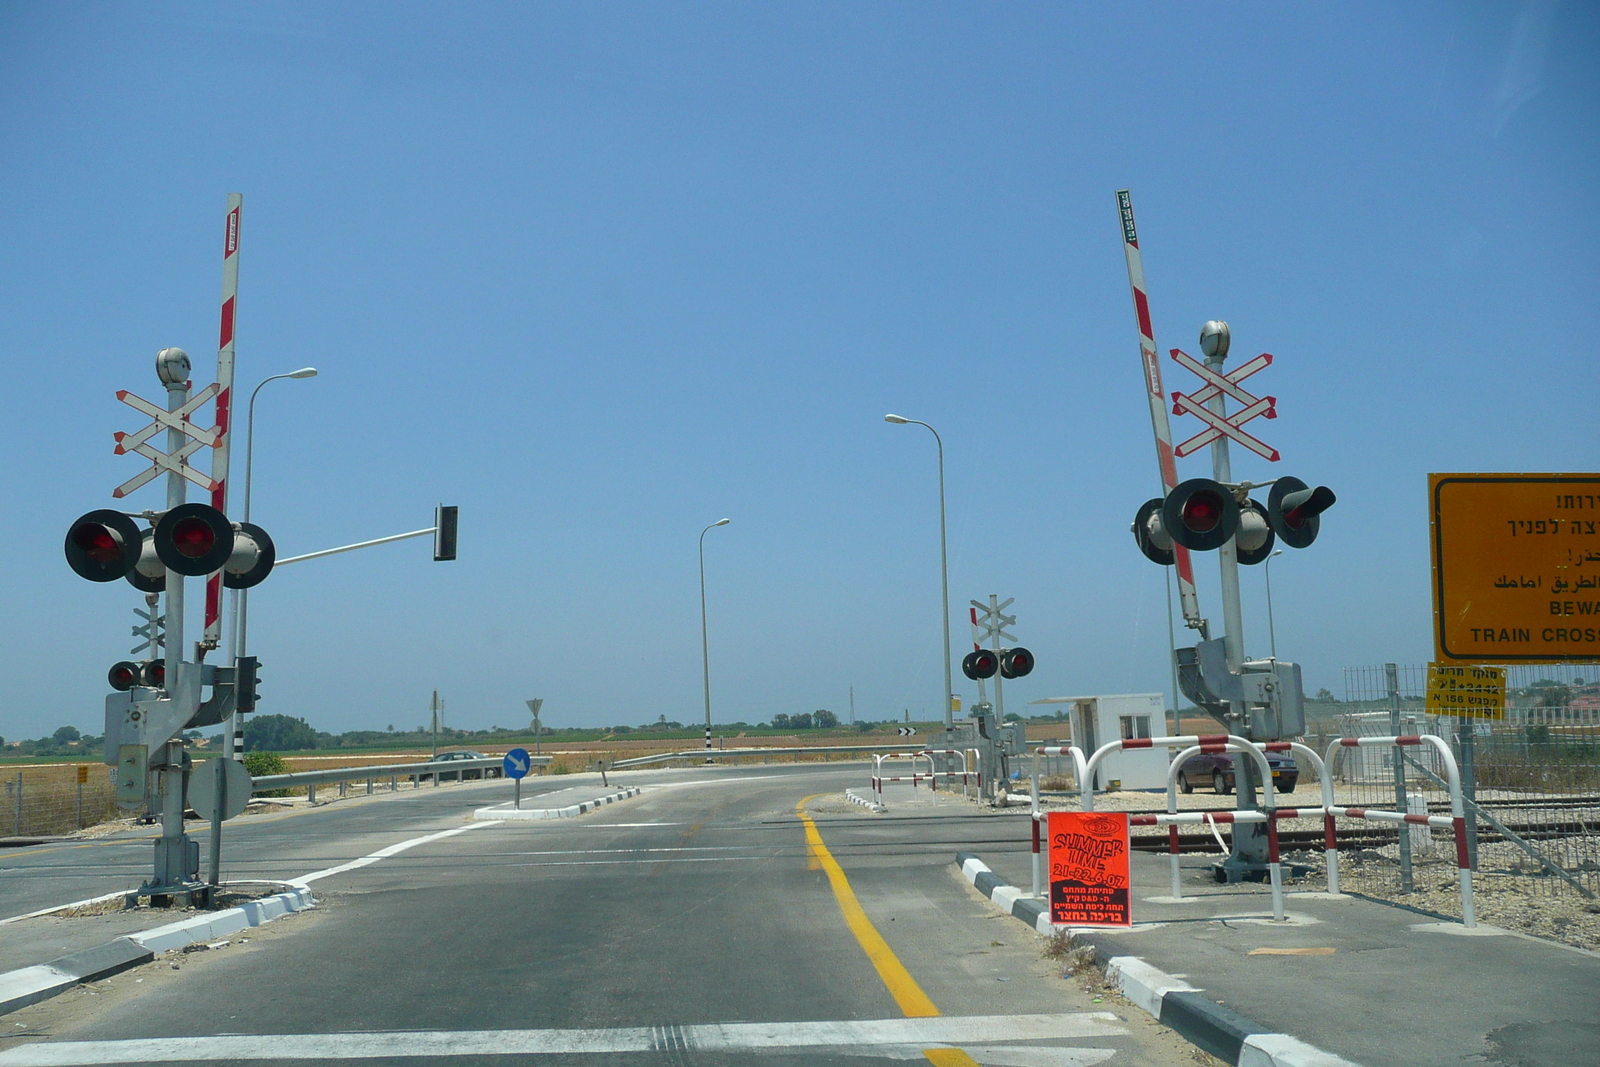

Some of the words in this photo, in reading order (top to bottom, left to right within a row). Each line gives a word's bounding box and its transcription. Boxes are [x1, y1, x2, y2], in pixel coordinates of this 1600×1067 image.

[1507, 519, 1559, 537] לפניך
[1494, 575, 1542, 589] امامك
[1470, 628, 1531, 643] TRAIN
[1542, 628, 1600, 643] CROS
[1433, 693, 1441, 701] א
[1446, 695, 1464, 704] 156
[1468, 696, 1498, 706] מפגש
[1053, 833, 1124, 857] SUMMER
[1067, 846, 1106, 870] TIME
[1053, 863, 1125, 888] 21-22.6.07
[1087, 887, 1115, 895] פתיחת
[1054, 902, 1084, 910] השמיים
[1105, 904, 1124, 912] תחת
[1057, 911, 1088, 921] בחצר
[1090, 912, 1123, 922] בריכה
